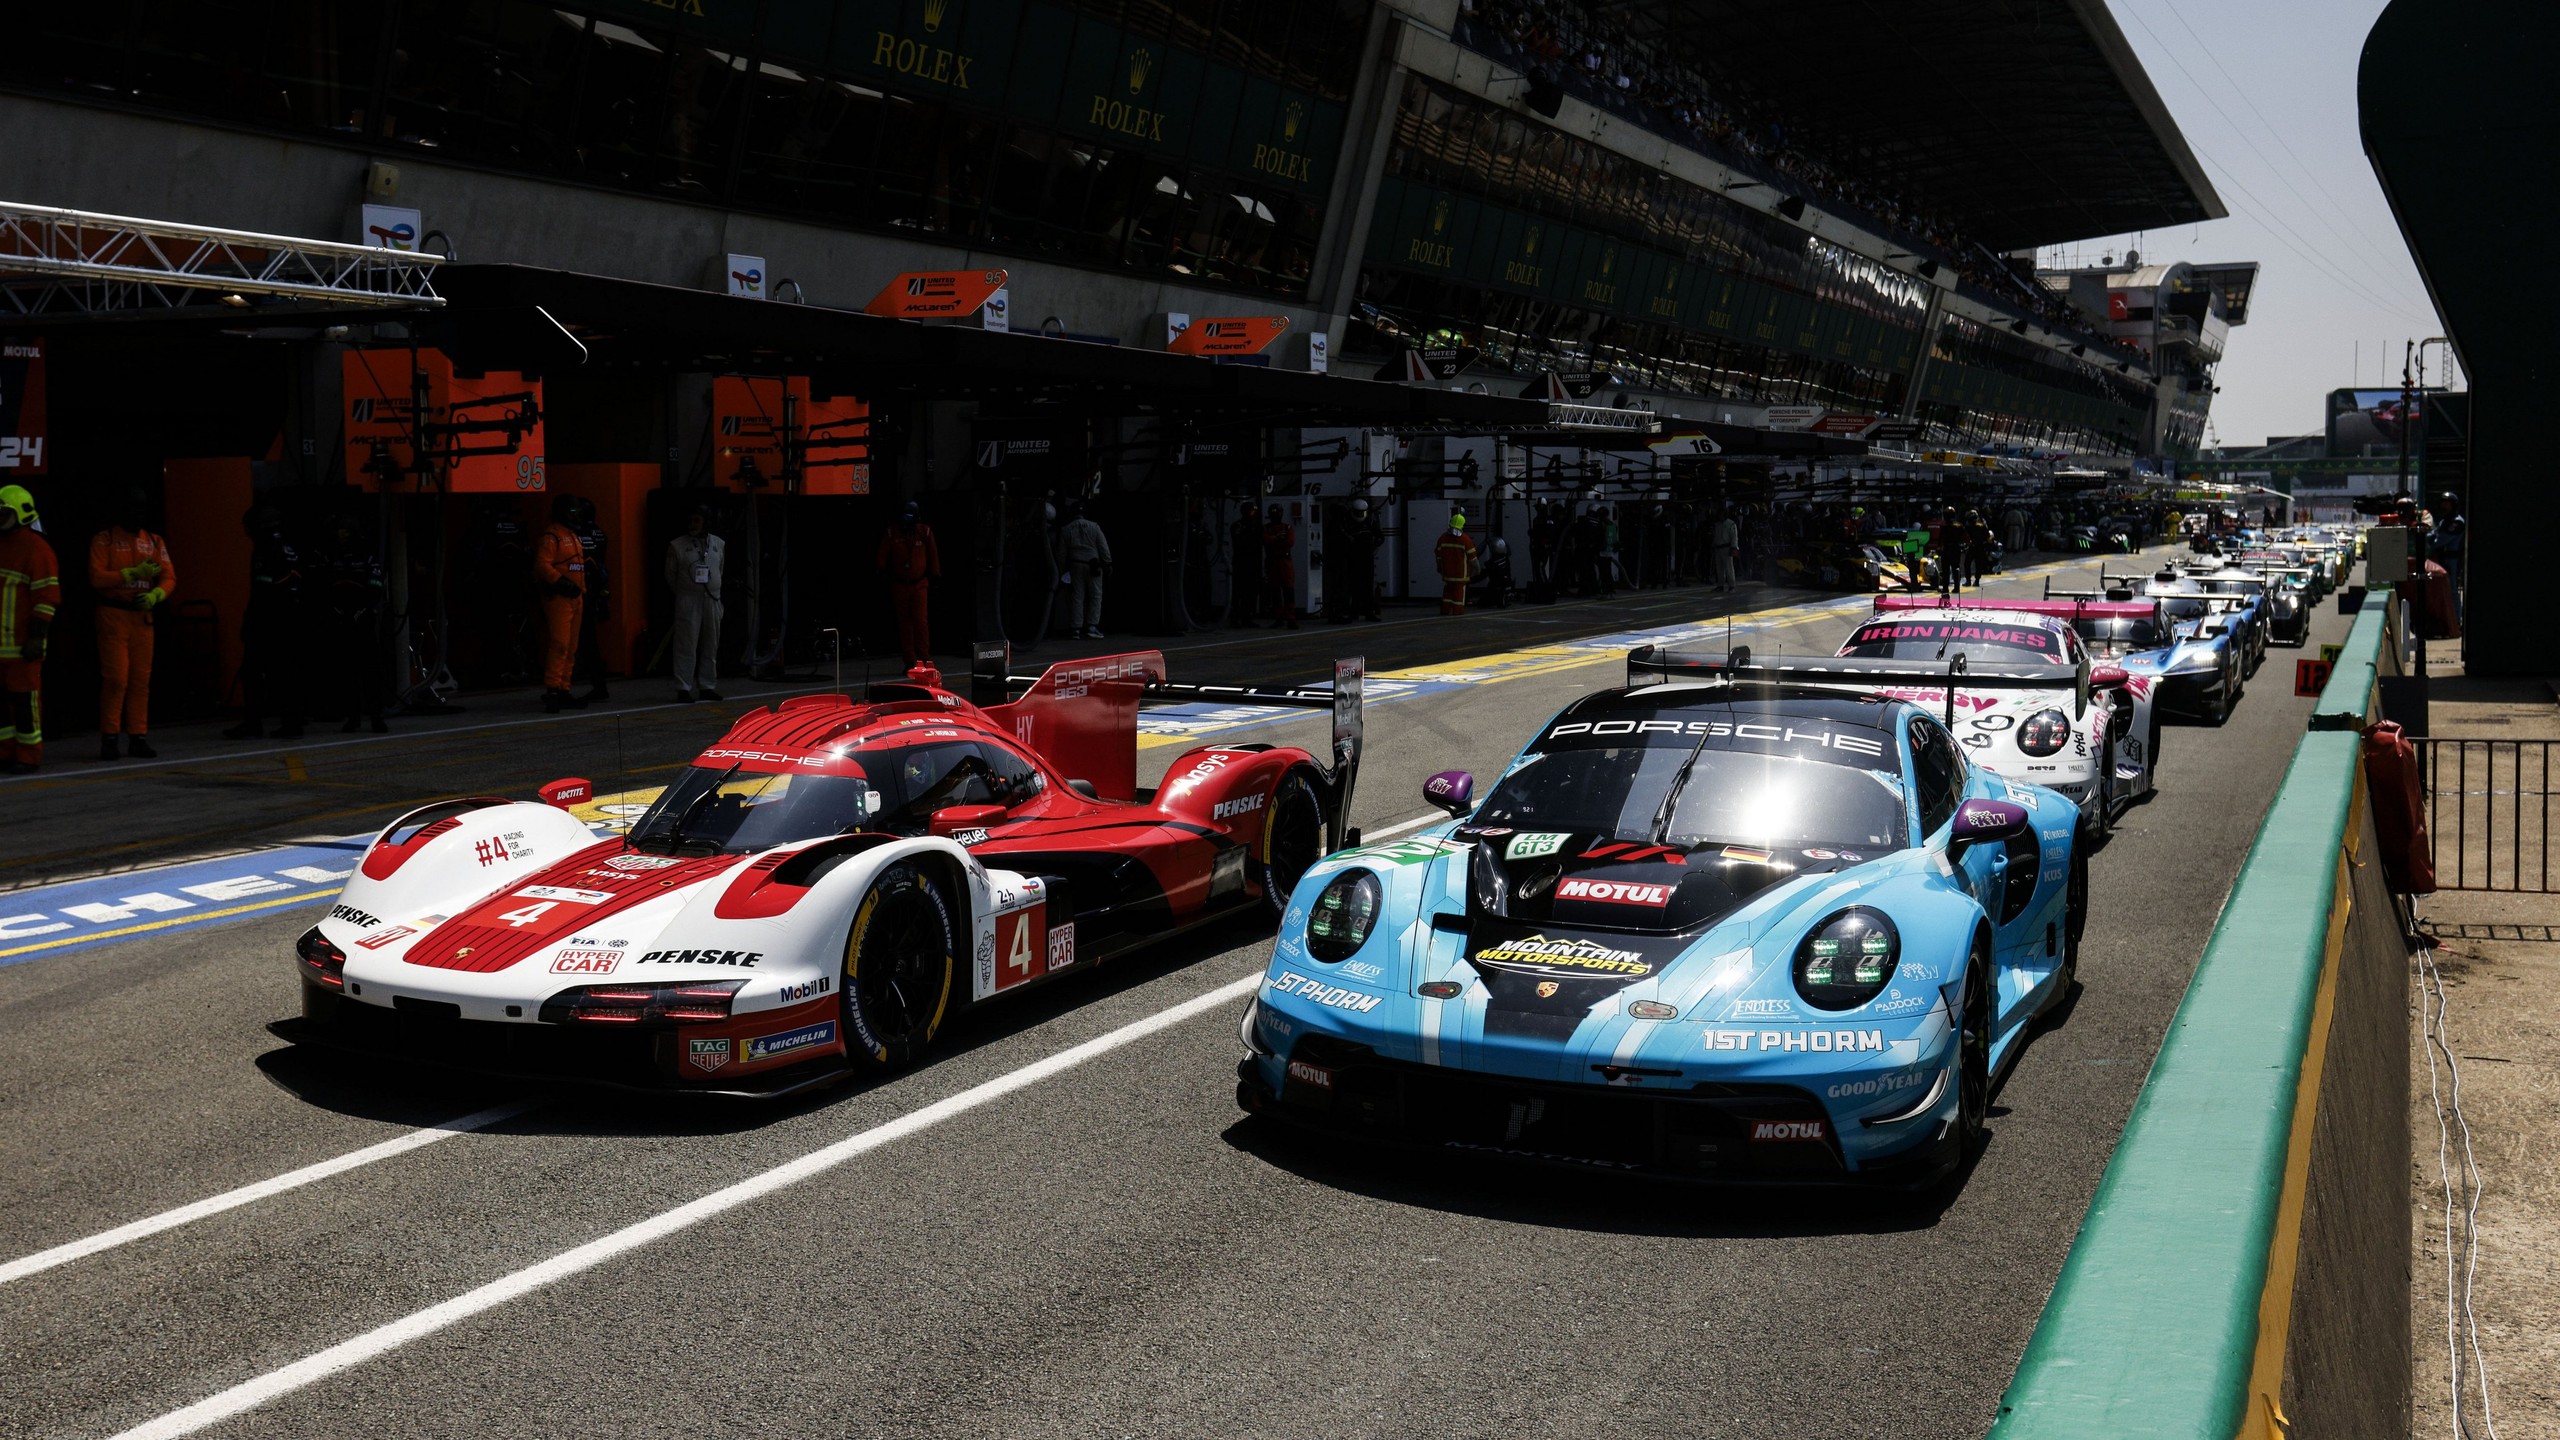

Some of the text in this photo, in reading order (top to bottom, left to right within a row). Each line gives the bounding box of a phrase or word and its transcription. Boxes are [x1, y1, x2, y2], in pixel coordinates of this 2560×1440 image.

[872, 31, 974, 90] ROLEX
[1088, 95, 1167, 142] ROLEX
[1252, 143, 1312, 183] ROLEX
[1408, 238, 1453, 268] ROLEX
[985, 271, 1002, 285] 95
[1505, 260, 1543, 288] ROLEX
[1584, 279, 1617, 304] ROLEX
[904, 301, 957, 312] McLaren
[1651, 296, 1679, 318] ROLEX
[1271, 318, 1286, 329] 59
[4, 345, 41, 358] MOTUL
[1203, 342, 1248, 350] McLaren
[1424, 349, 1457, 357] UNITED
[1442, 364, 1456, 375] 22
[1578, 385, 1591, 395] 23
[304, 439, 315, 455] 31
[1007, 440, 1050, 449] UNITED
[1194, 444, 1229, 452] UNITED
[1689, 439, 1713, 453] 16
[517, 455, 545, 489] 95
[852, 464, 870, 494] 59
[1303, 482, 1323, 496] 16
[1861, 625, 2047, 649] IRON DAMES
[1054, 661, 1143, 687] PORSCHE
[2302, 664, 2328, 689] 12
[1054, 684, 1088, 700] 963
[1016, 715, 1034, 745] HY
[1549, 719, 1882, 757] PORSCHE
[2072, 730, 2088, 758] total
[701, 749, 825, 768] PORSCHE
[1174, 752, 1229, 797] Ansys
[556, 787, 585, 800] LOCTITE
[1213, 793, 1266, 820] PENSKE
[1977, 813, 2007, 828] KW
[503, 831, 525, 842] RACING
[508, 842, 520, 850] FOR
[955, 828, 988, 847] Heuer
[475, 836, 509, 868] #4
[511, 848, 535, 860] CHARITY
[1513, 841, 1556, 855] GT3
[576, 868, 641, 880] Ansys
[997, 888, 1015, 904] 24h
[1559, 880, 1665, 904] MOTUL
[328, 904, 382, 929] PENSKE
[497, 901, 561, 927] 4
[930, 889, 952, 950] MICHELIN
[1008, 912, 1033, 976] 4
[1050, 925, 1073, 946] HYPER
[562, 951, 617, 961] HYPER
[637, 950, 763, 968] PENSKE
[1050, 940, 1073, 967] CAR
[1496, 940, 1643, 962] MOUNTAIN
[556, 959, 613, 972] CAR
[1343, 960, 1385, 977] ENDLESS
[1476, 949, 1649, 975] MOTORSPORTS
[780, 977, 829, 1003] Mobil 1
[1271, 971, 1384, 1014] 1ST PHORM
[1735, 999, 1791, 1014] ENDLESS
[1874, 996, 1926, 1013] PADDOCK
[1888, 1006, 1920, 1017] LEGENDS
[850, 985, 876, 1050] MICHELIN
[693, 1041, 727, 1051] TAG
[769, 1029, 828, 1051] MICHELIN
[1702, 1029, 1885, 1053] 1ST PHORM
[691, 1053, 728, 1069] HEUER
[1291, 1062, 1330, 1087] MOTUL
[1827, 1071, 1923, 1098] GOODYEAR
[1754, 1122, 1823, 1139] MOTUL
